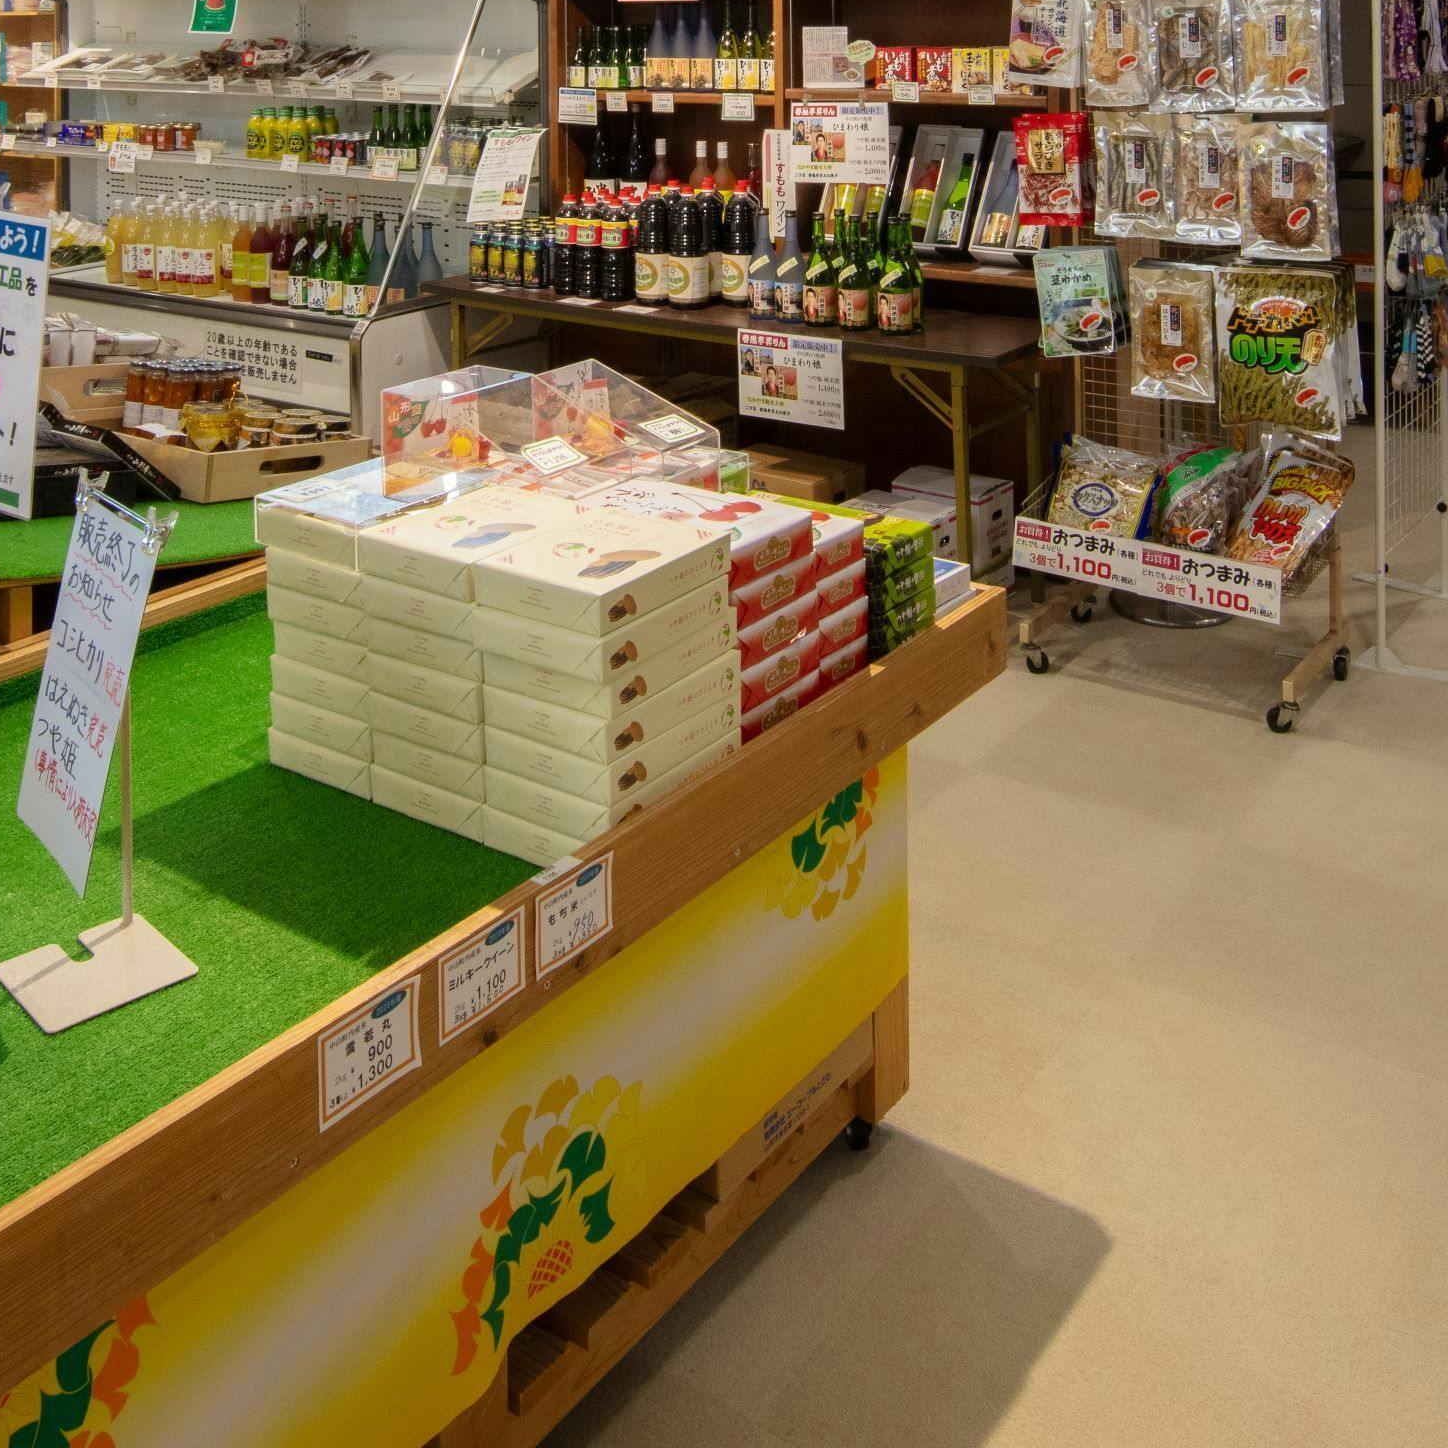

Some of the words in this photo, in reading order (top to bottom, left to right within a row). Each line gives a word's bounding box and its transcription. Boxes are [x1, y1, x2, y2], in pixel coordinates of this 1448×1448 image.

[884, 50, 902, 81] いも煮
[926, 49, 944, 81] いも煮
[832, 123, 870, 131] ひまわり娘
[1034, 141, 1043, 170] サラミ
[776, 162, 786, 198] すもも
[775, 200, 786, 233] ワイン
[25, 276, 38, 297] を
[207, 332, 297, 357] 20歳以上の年齢である
[207, 346, 297, 371] ことを確認できない場合
[1231, 333, 1309, 375] のり天
[783, 357, 822, 370] ひまわり娘
[76, 512, 140, 594] 販売終了の
[1015, 537, 1038, 550] どれでも
[1040, 542, 1062, 552] よりどり
[1018, 524, 1050, 538] お買得!
[1052, 529, 1115, 557] おつまみ
[1117, 548, 1139, 561] (各種)
[1029, 552, 1057, 568] 3個で
[1057, 552, 1112, 580] 1,100
[1112, 573, 1137, 587] 円(税込)
[1141, 568, 1166, 581] どれでも
[1168, 574, 1192, 585] よりどり
[1144, 551, 1179, 569] お買得!
[1182, 558, 1251, 587] おつまみ
[1252, 577, 1277, 591] (各種)
[67, 564, 116, 623] お知らせ
[1157, 581, 1186, 598] 3個で
[1188, 583, 1250, 612] 1,100
[1249, 606, 1277, 619] 円(税込)
[56, 619, 103, 684] コシヒカリ
[103, 656, 126, 707] 完売
[44, 673, 88, 737] はえぬき
[85, 710, 108, 759] 完売
[37, 718, 80, 781] つや姫
[547, 901, 578, 926] もち米
[448, 942, 514, 992] ミルキークイーン
[368, 1034, 393, 1062] 900
